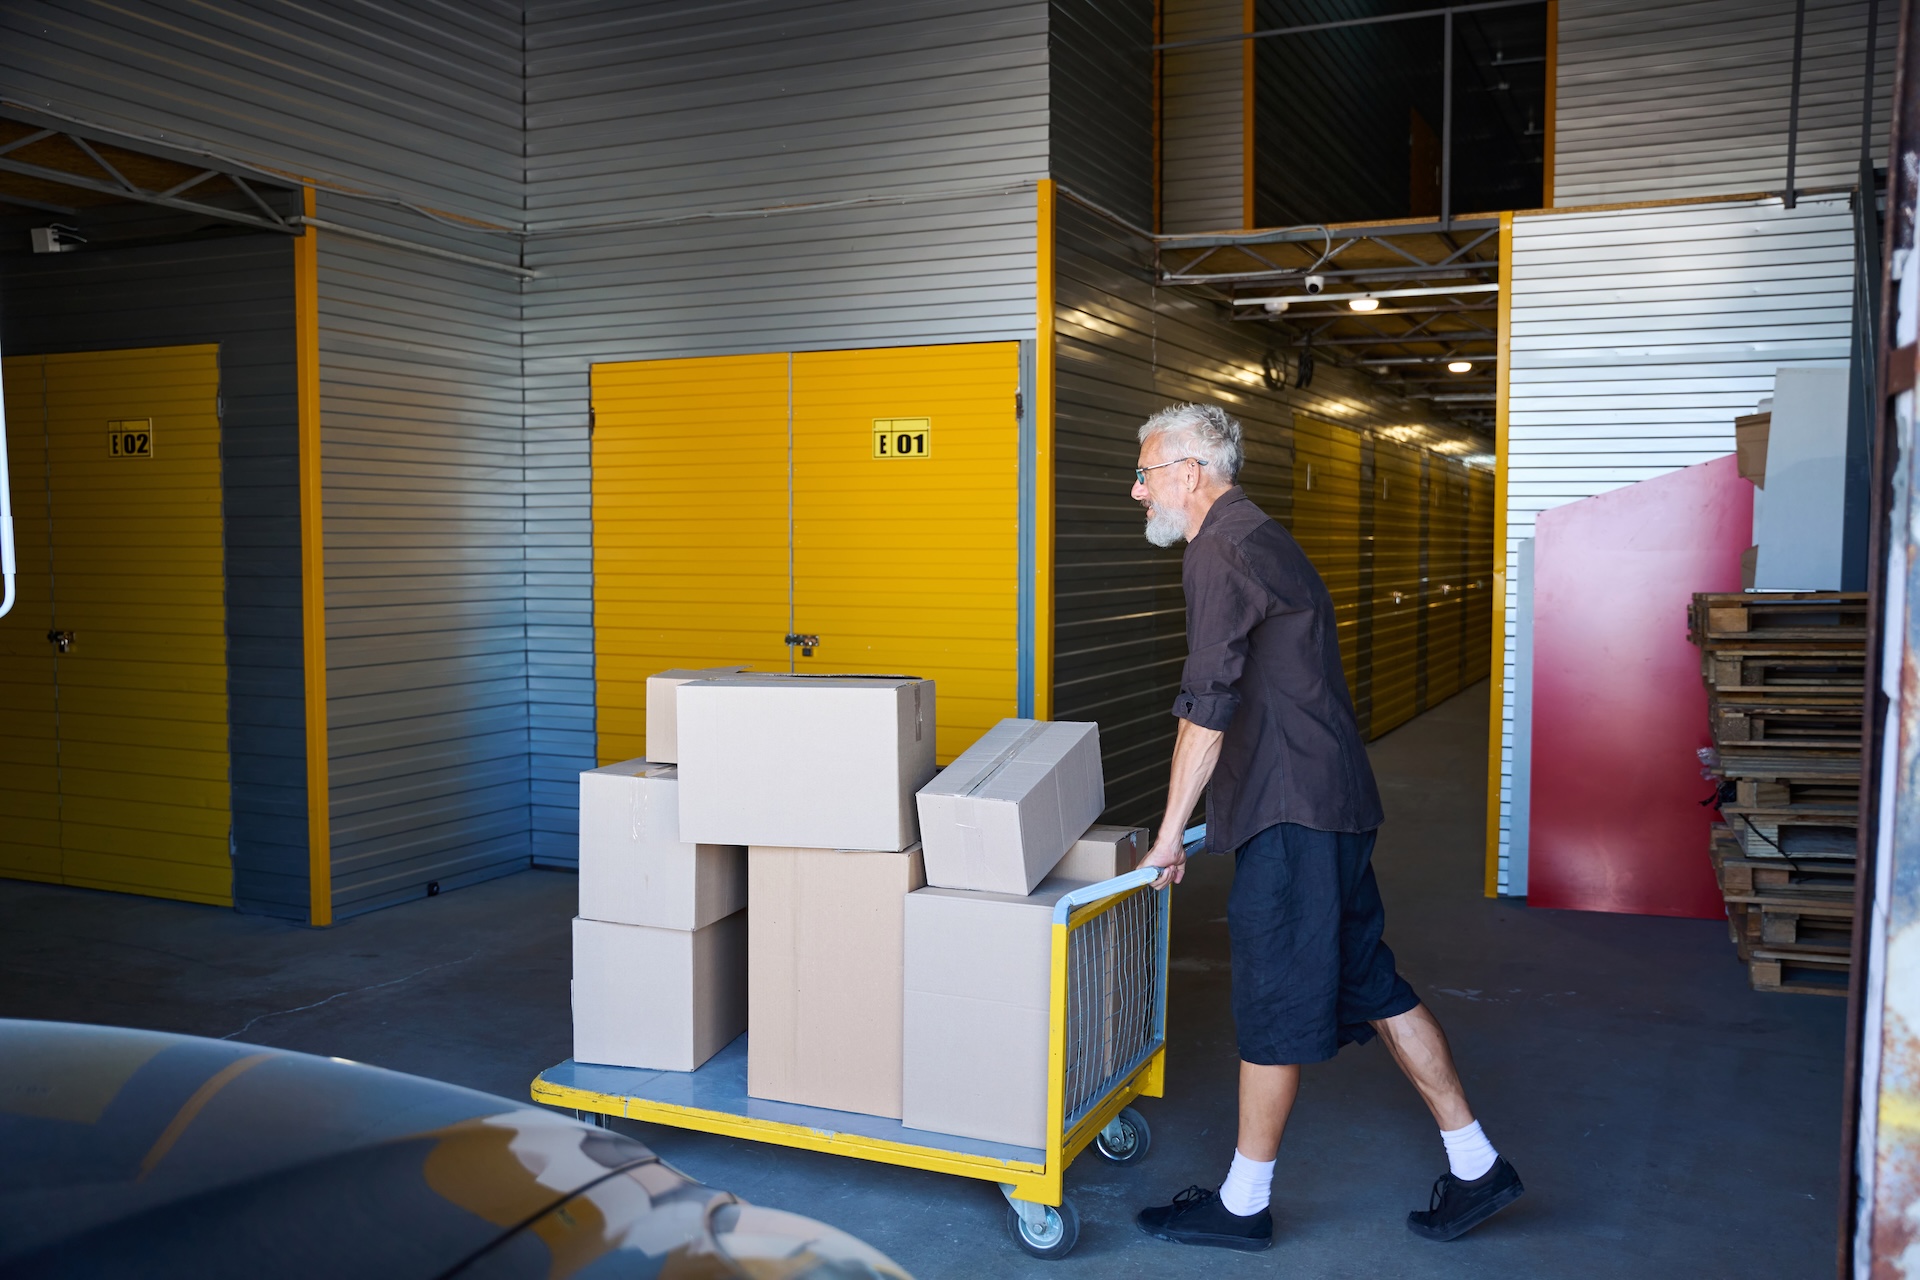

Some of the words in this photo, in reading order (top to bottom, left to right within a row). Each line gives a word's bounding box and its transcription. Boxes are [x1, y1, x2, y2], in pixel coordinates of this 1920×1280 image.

[112, 435, 119, 454] E
[124, 433, 148, 454] 02
[880, 435, 887, 454] E
[897, 434, 924, 454] 01
